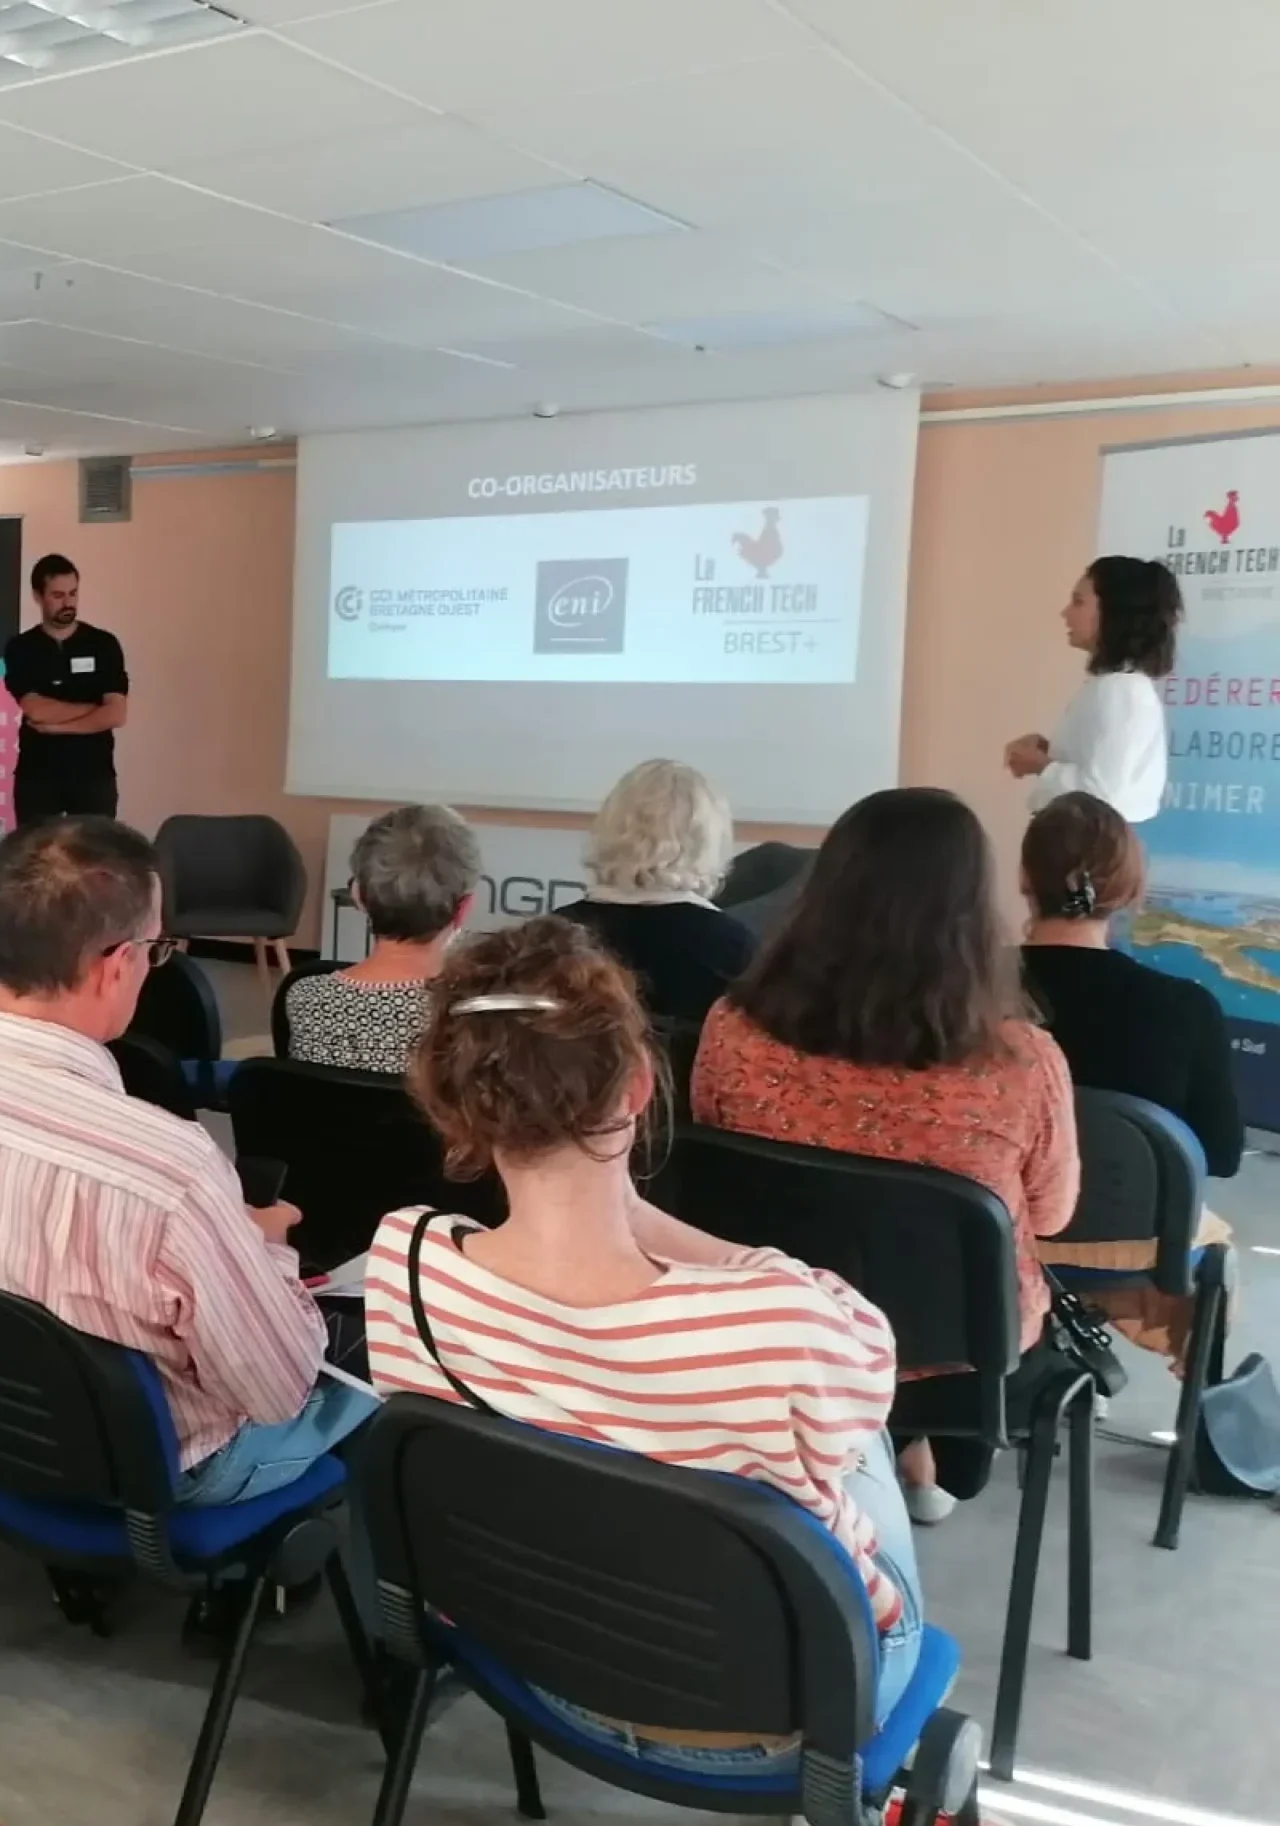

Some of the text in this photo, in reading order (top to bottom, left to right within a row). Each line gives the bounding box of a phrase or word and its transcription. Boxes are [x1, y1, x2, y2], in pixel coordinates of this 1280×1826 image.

[468, 464, 697, 498] CO-ORGANISATEURS
[1167, 525, 1186, 548] La
[694, 553, 716, 582] La
[1235, 547, 1280, 573] TECH
[370, 603, 481, 616] BRETAGNE OUEST
[553, 590, 603, 615] eni
[692, 584, 818, 614] FRENCH TECH
[723, 630, 820, 654] BREST+
[1164, 781, 1265, 813] NIMER
